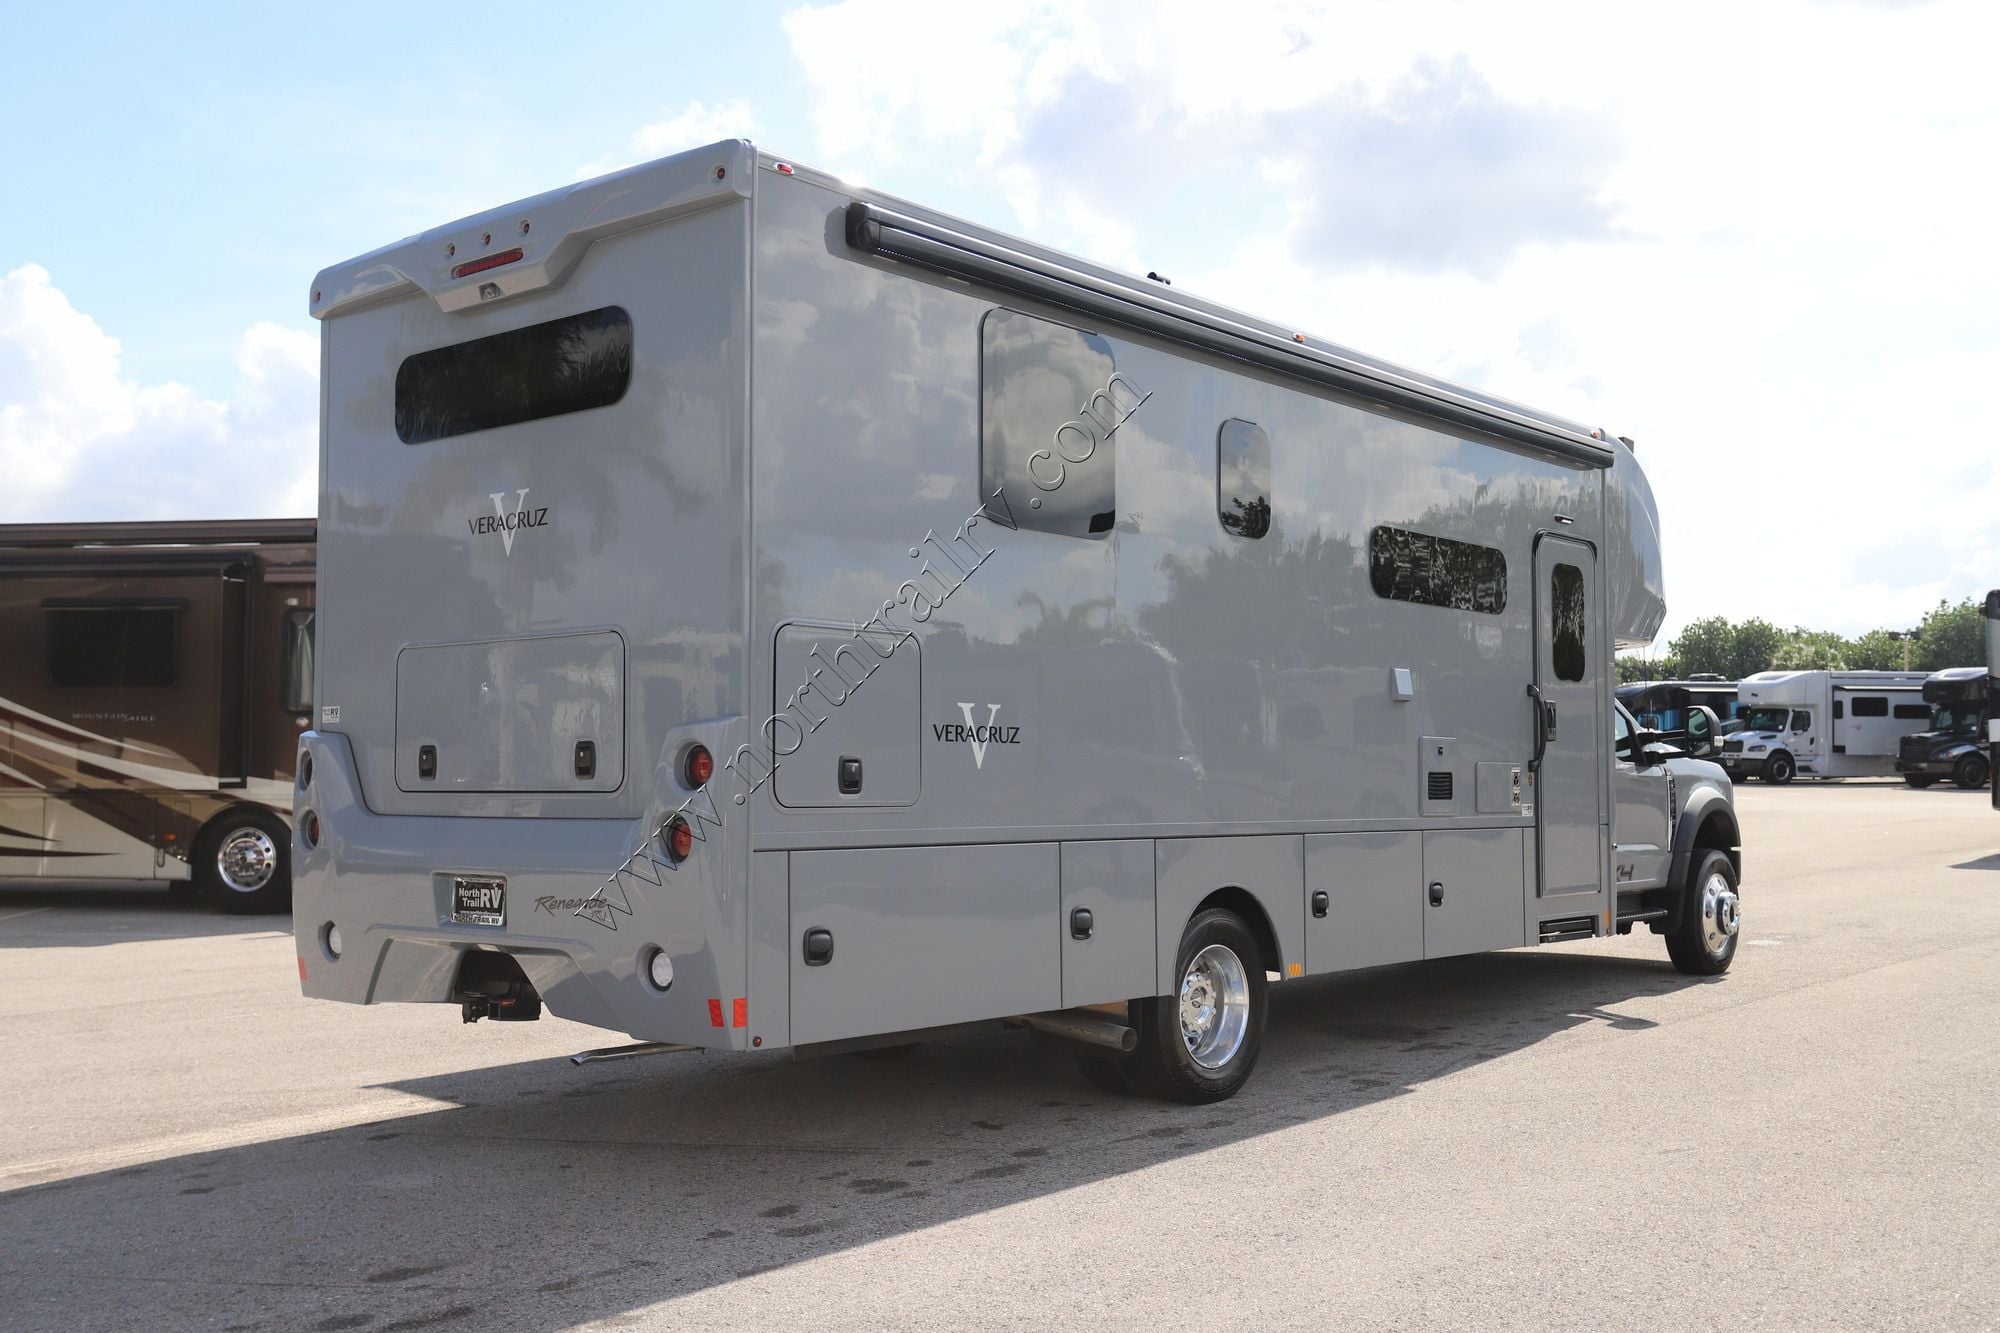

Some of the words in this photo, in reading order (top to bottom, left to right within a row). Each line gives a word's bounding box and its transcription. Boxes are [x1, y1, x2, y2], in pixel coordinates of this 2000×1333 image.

[468, 507, 549, 536] VERACRUZ
[488, 487, 530, 558] V
[932, 723, 1021, 744] VERACRUZ
[957, 702, 1002, 770] V
[458, 887, 480, 897] North
[462, 897, 480, 907] Trail
[480, 887, 502, 909] RV
[534, 895, 608, 917] Renegade
